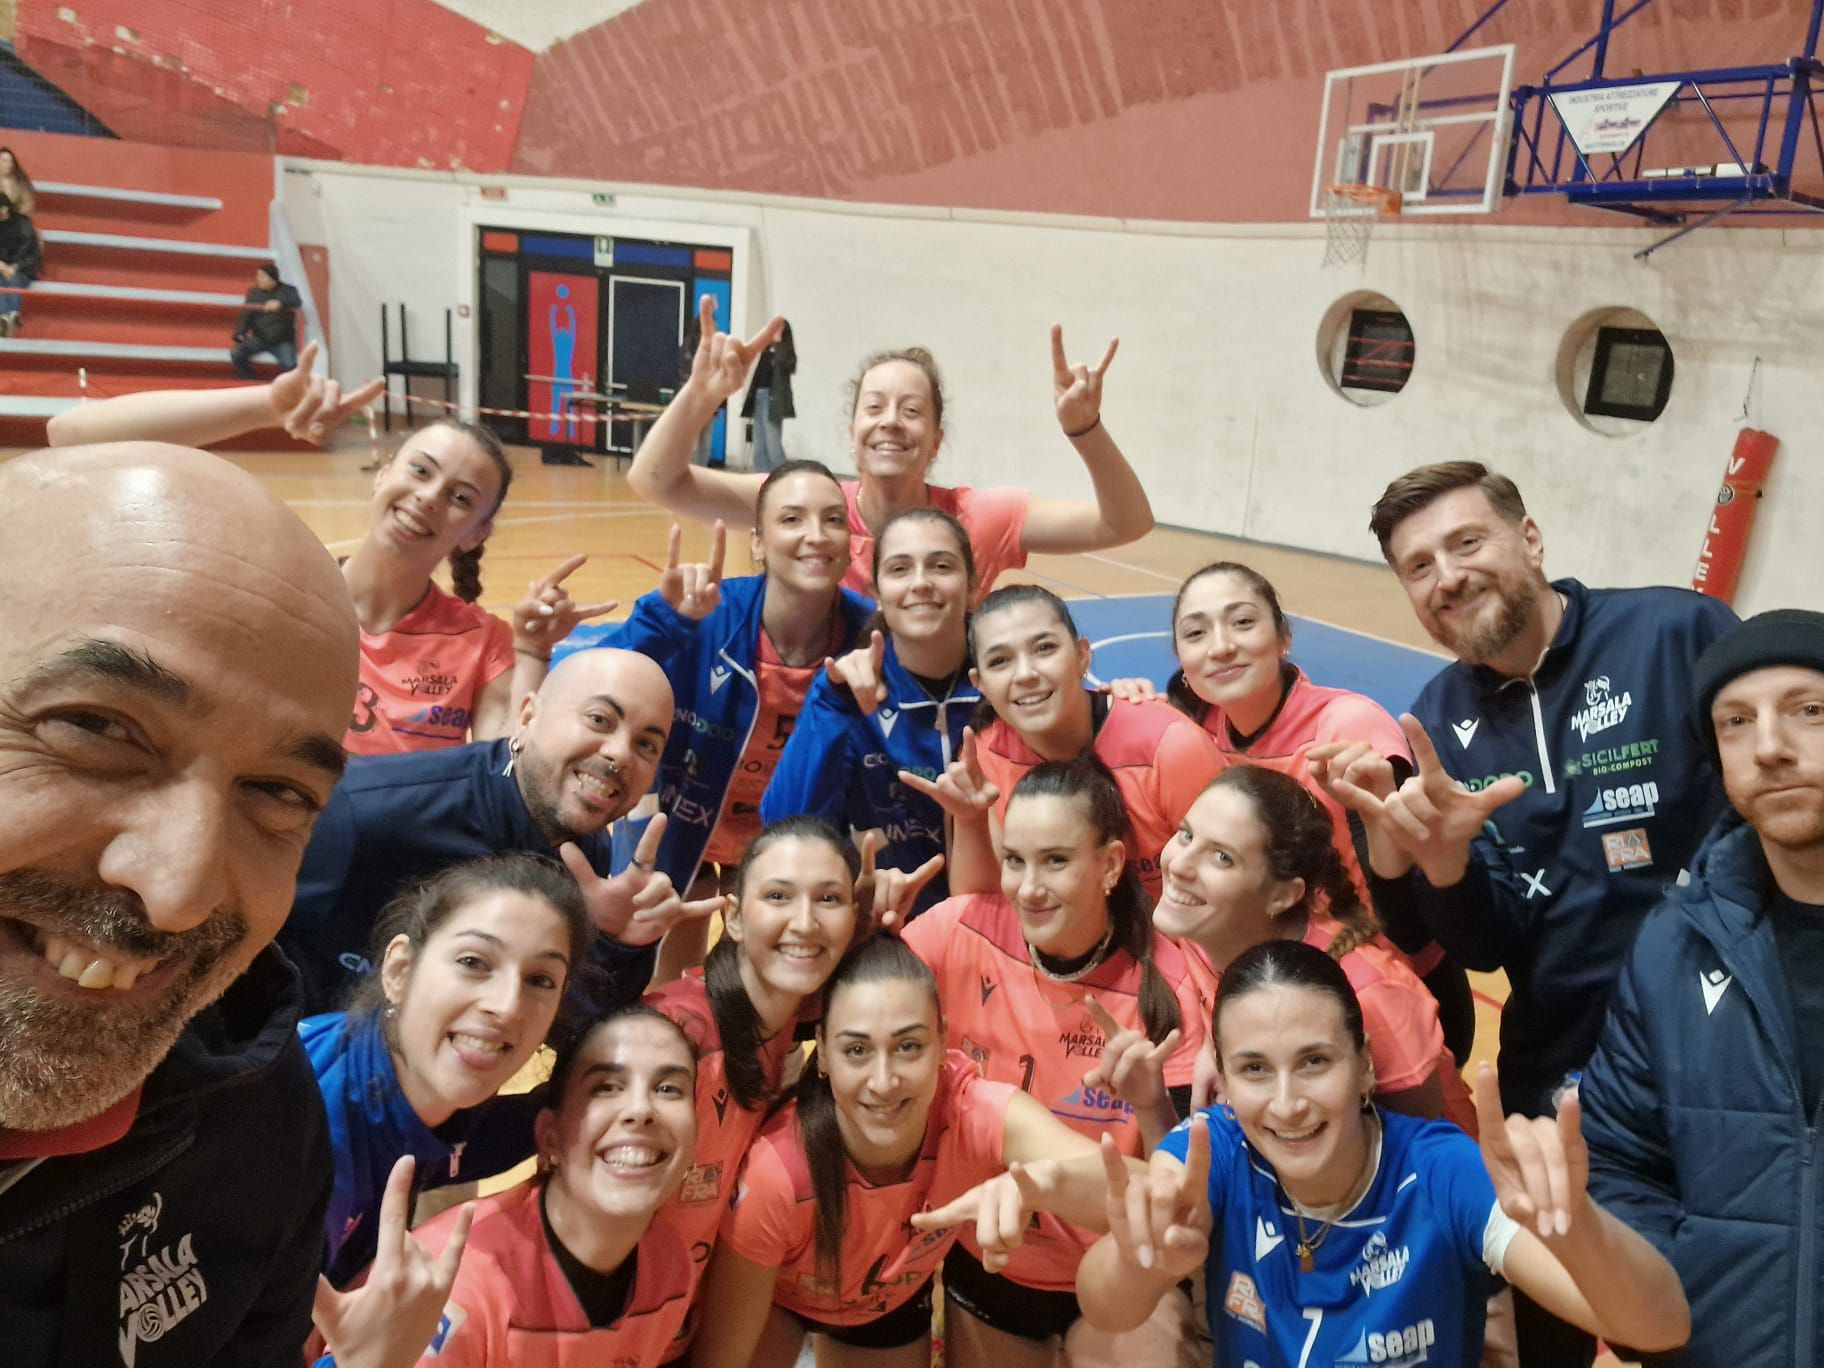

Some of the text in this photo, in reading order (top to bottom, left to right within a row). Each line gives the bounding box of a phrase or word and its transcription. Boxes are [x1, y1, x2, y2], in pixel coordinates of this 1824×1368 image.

[1571, 691, 1632, 731] MARSALA
[1579, 706, 1628, 745] VOLLEY
[1582, 738, 1659, 768] SICILFERT
[1593, 756, 1652, 777] BIO-COMPOST
[1602, 781, 1659, 813] seap
[1367, 1318, 1435, 1364] seap
